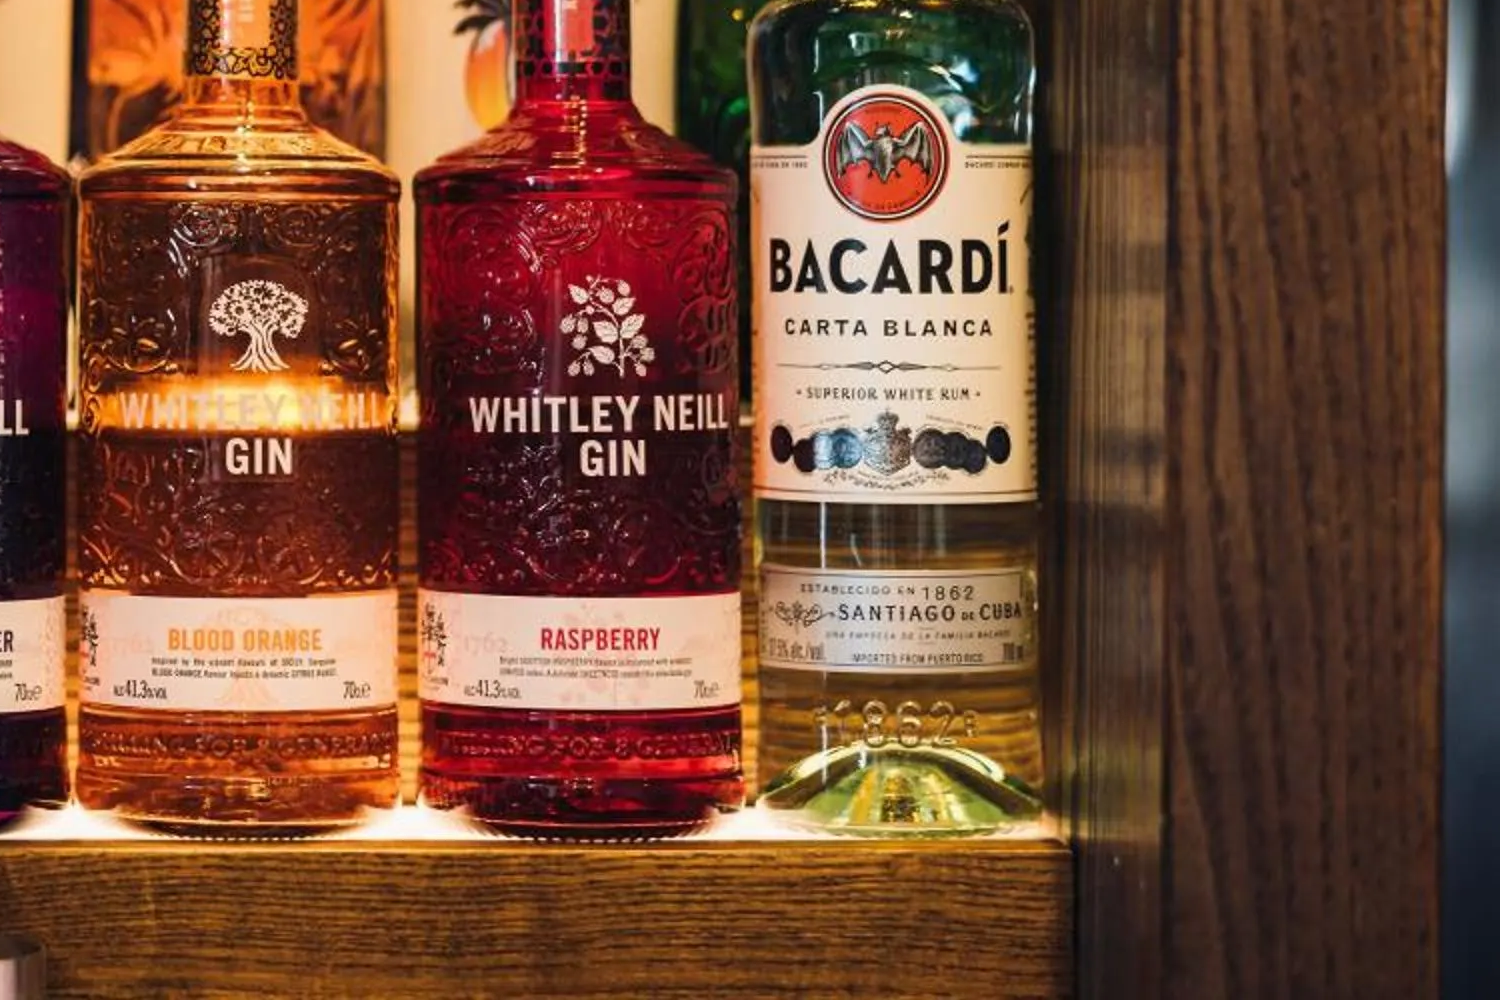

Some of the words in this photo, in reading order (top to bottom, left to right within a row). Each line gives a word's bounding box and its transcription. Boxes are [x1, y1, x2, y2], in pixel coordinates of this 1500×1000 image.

[769, 220, 1011, 294] BACARDÍ
[785, 319, 868, 336] CARTA
[883, 319, 993, 337] BLANCA
[806, 386, 878, 400] SUPERIOR
[884, 387, 934, 401] WHITE
[940, 387, 970, 401] RUM
[120, 392, 290, 431] WHITLEY
[301, 391, 382, 431] NEILL
[469, 395, 640, 433] WHITLEY
[653, 393, 729, 431] NEILL
[225, 437, 293, 475] GIN
[579, 439, 647, 477] GIN
[801, 583, 891, 595] ESTABLECIDO
[898, 585, 915, 595] EN
[922, 585, 974, 601] 1862
[838, 603, 956, 621] SANTIAGO
[961, 611, 975, 621] DE
[979, 602, 1022, 620] CUBA
[168, 628, 234, 651] BLOOD
[243, 628, 323, 651] ORANGE
[541, 628, 661, 651] RASPBERRY
[900, 653, 925, 663] FROM
